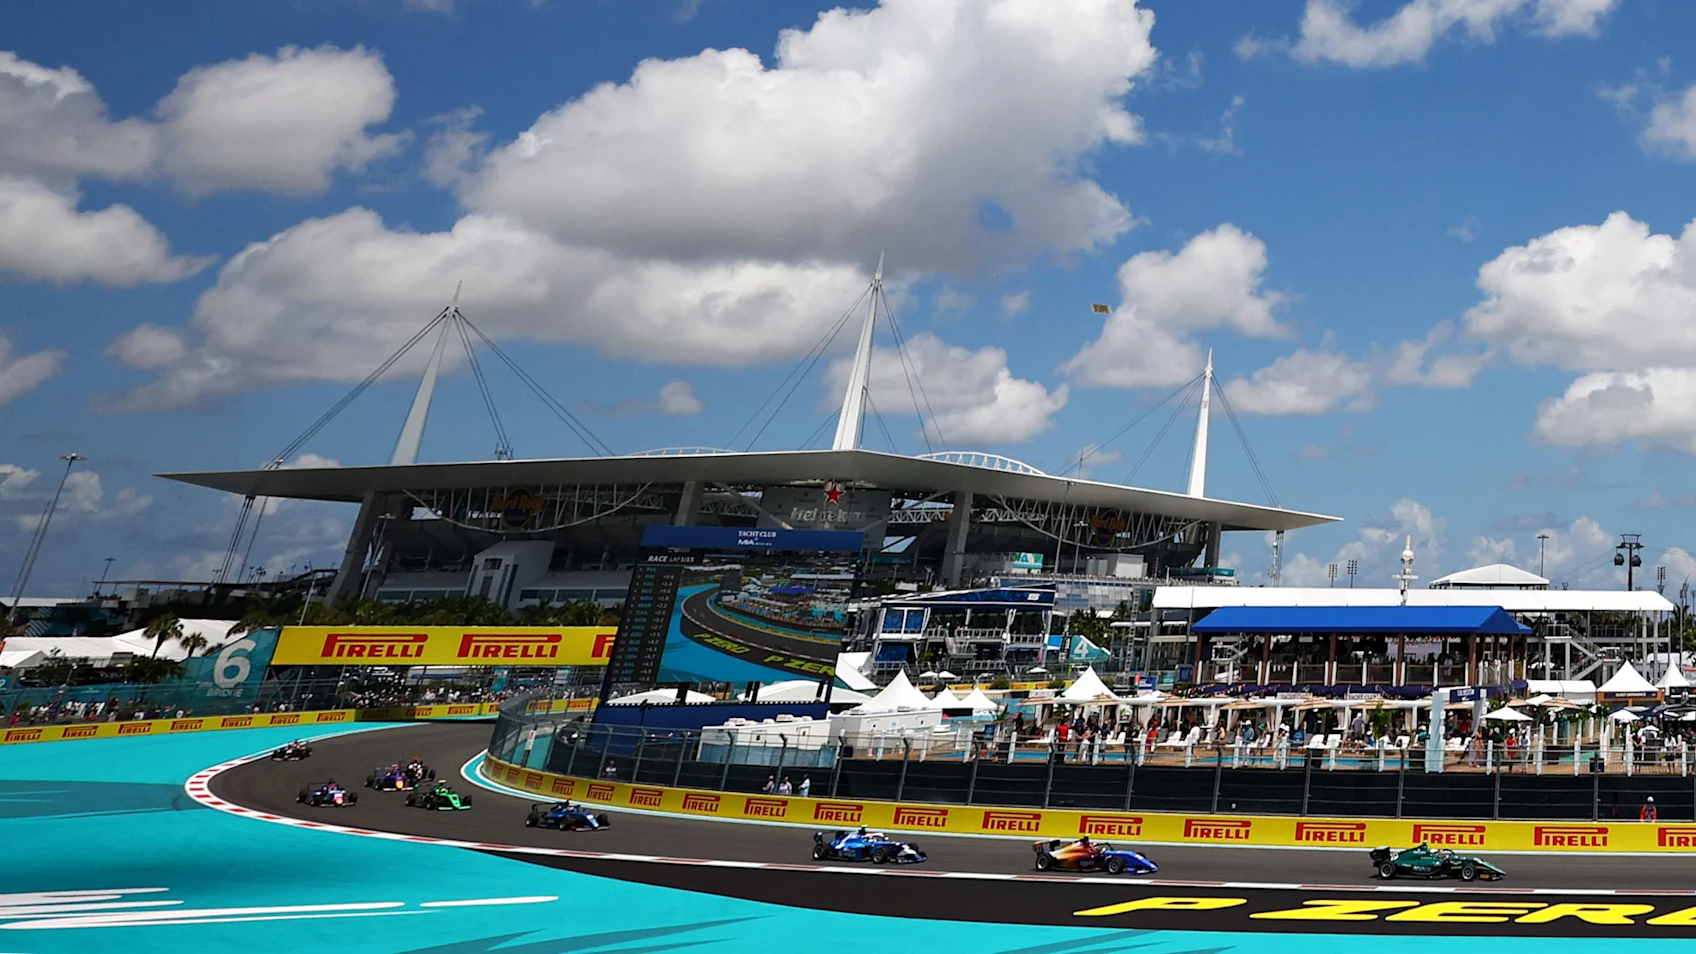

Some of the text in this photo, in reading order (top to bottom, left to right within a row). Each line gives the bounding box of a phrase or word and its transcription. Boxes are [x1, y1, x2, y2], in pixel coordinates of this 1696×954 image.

[647, 555, 669, 563] RACE
[321, 634, 428, 658] PIRELLI
[457, 634, 562, 658] PIRELLI
[704, 638, 751, 654] ZERO
[1073, 640, 1089, 659] 4
[214, 639, 256, 689] 6
[763, 655, 784, 663] P
[170, 719, 204, 731] PIRELLI
[221, 717, 253, 728] PIRELLI
[273, 714, 300, 725] PIRELLI
[317, 712, 346, 722] PIRELLI
[4, 729, 43, 742] PIRELLI
[62, 726, 98, 738] PIRELLI
[118, 722, 152, 734] PIRELLI
[586, 783, 615, 802] PIRELLI
[629, 788, 664, 807] PIRELLI
[682, 793, 721, 813] PIRELLI
[743, 798, 788, 818] PIRELLI
[813, 803, 864, 823] PIRELLI
[893, 807, 949, 828] PIRELLI
[982, 811, 1042, 832] PIRELLI
[1079, 815, 1143, 836] PIRELLI
[1184, 819, 1252, 840] PIRELLI
[1295, 822, 1367, 843] PIRELLI
[1412, 824, 1486, 845] PIRELLI
[1534, 826, 1609, 847] PIRELLI
[1072, 896, 1248, 917] P
